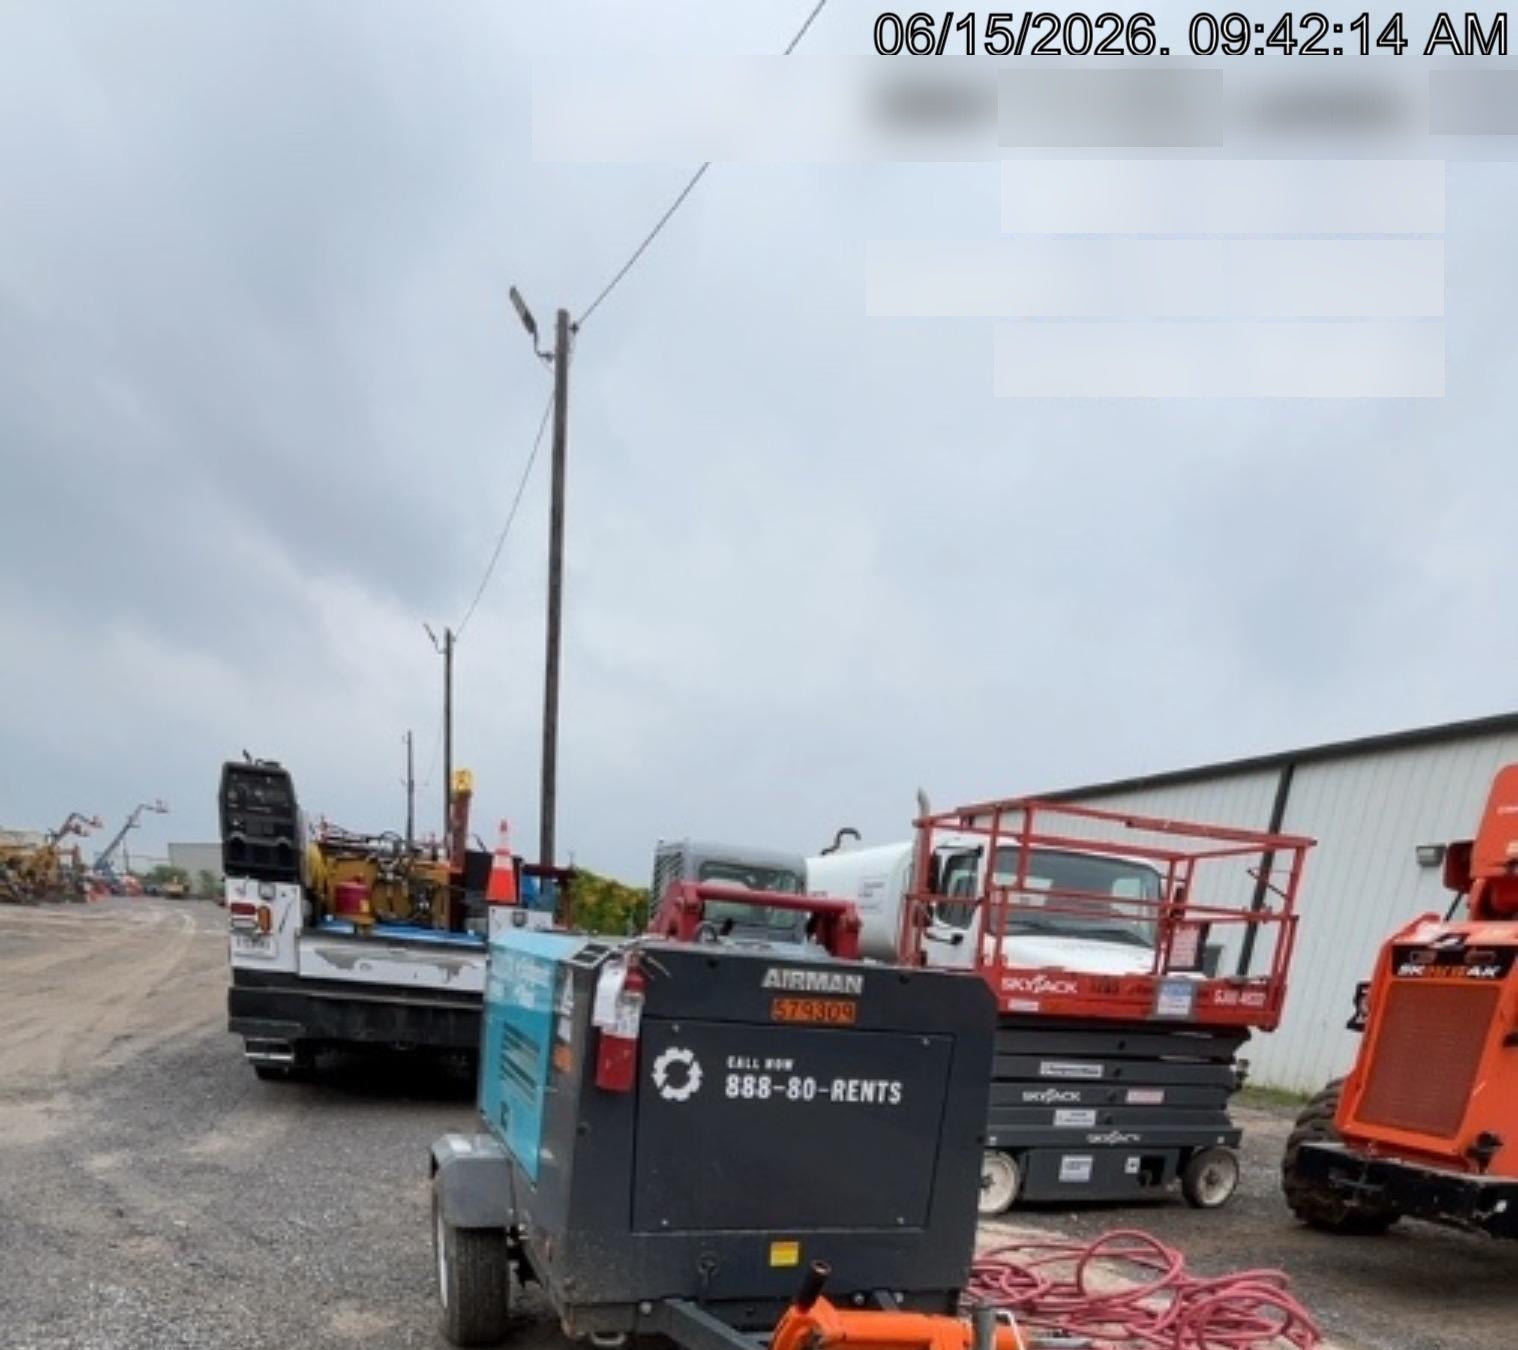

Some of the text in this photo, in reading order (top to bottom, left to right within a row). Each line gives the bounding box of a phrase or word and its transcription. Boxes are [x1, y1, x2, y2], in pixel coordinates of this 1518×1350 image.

[761, 967, 864, 994] AIRMAN
[1001, 974, 1078, 994] SKYJACK
[726, 1055, 794, 1071] CALL NOW
[724, 1073, 903, 1105] 888-80-RENTS
[1022, 1088, 1081, 1104] SKYJACK
